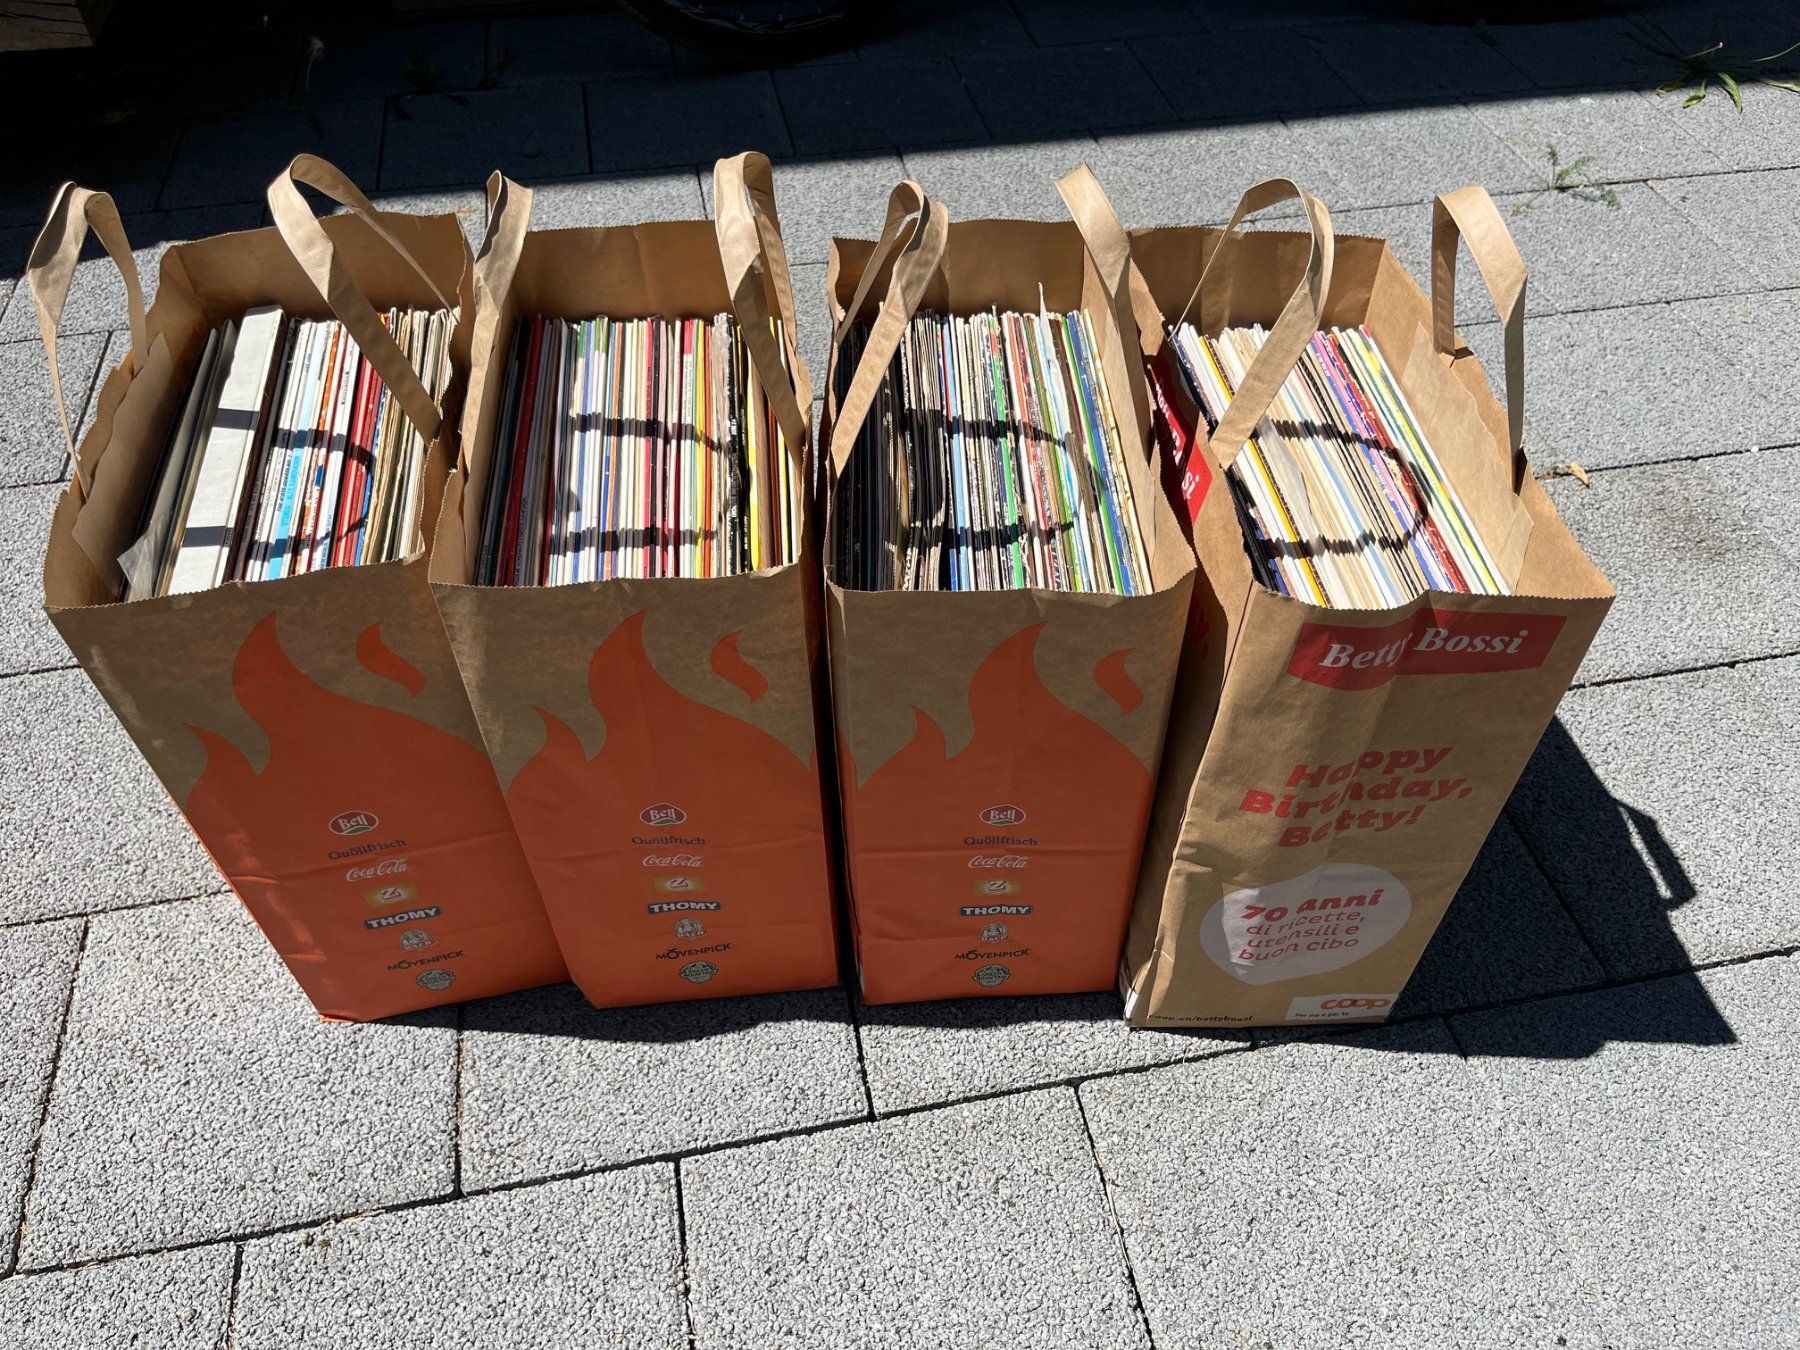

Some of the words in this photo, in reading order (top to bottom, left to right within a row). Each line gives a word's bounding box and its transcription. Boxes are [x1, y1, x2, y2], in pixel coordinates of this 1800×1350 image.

[1318, 632, 1413, 669] Betty
[1413, 627, 1529, 654] Bossi
[1286, 747, 1452, 788] Happy
[1239, 777, 1473, 819] Birthday,
[338, 814, 369, 831] Bell
[650, 808, 676, 821] Bell
[990, 809, 1016, 821] Bell
[1277, 805, 1426, 847] Betty!
[328, 839, 407, 860] Quöllfrisch
[632, 835, 706, 846] Quöllfrisch
[964, 836, 1038, 846] Quöllfrisch
[642, 854, 703, 867] Coca-Cola
[968, 855, 1030, 869] Coca-Cola
[346, 858, 408, 882] Coca-Cola
[650, 902, 718, 914] THOMY
[963, 906, 1031, 915] THOMY
[1241, 905, 1289, 922] 70
[1296, 889, 1384, 915] anni
[367, 907, 438, 928] THOMY
[1246, 925, 1273, 936] di
[1278, 911, 1365, 934] ricette,
[1247, 923, 1340, 948] utensili
[1344, 925, 1360, 935] e
[656, 943, 732, 960] MÖVENPICK
[955, 949, 1030, 961] MÖVENPICK
[1238, 943, 1299, 961] buon
[1306, 938, 1359, 952] cibo
[387, 950, 465, 970] MÖVENPICK
[1320, 998, 1391, 1010] coop
